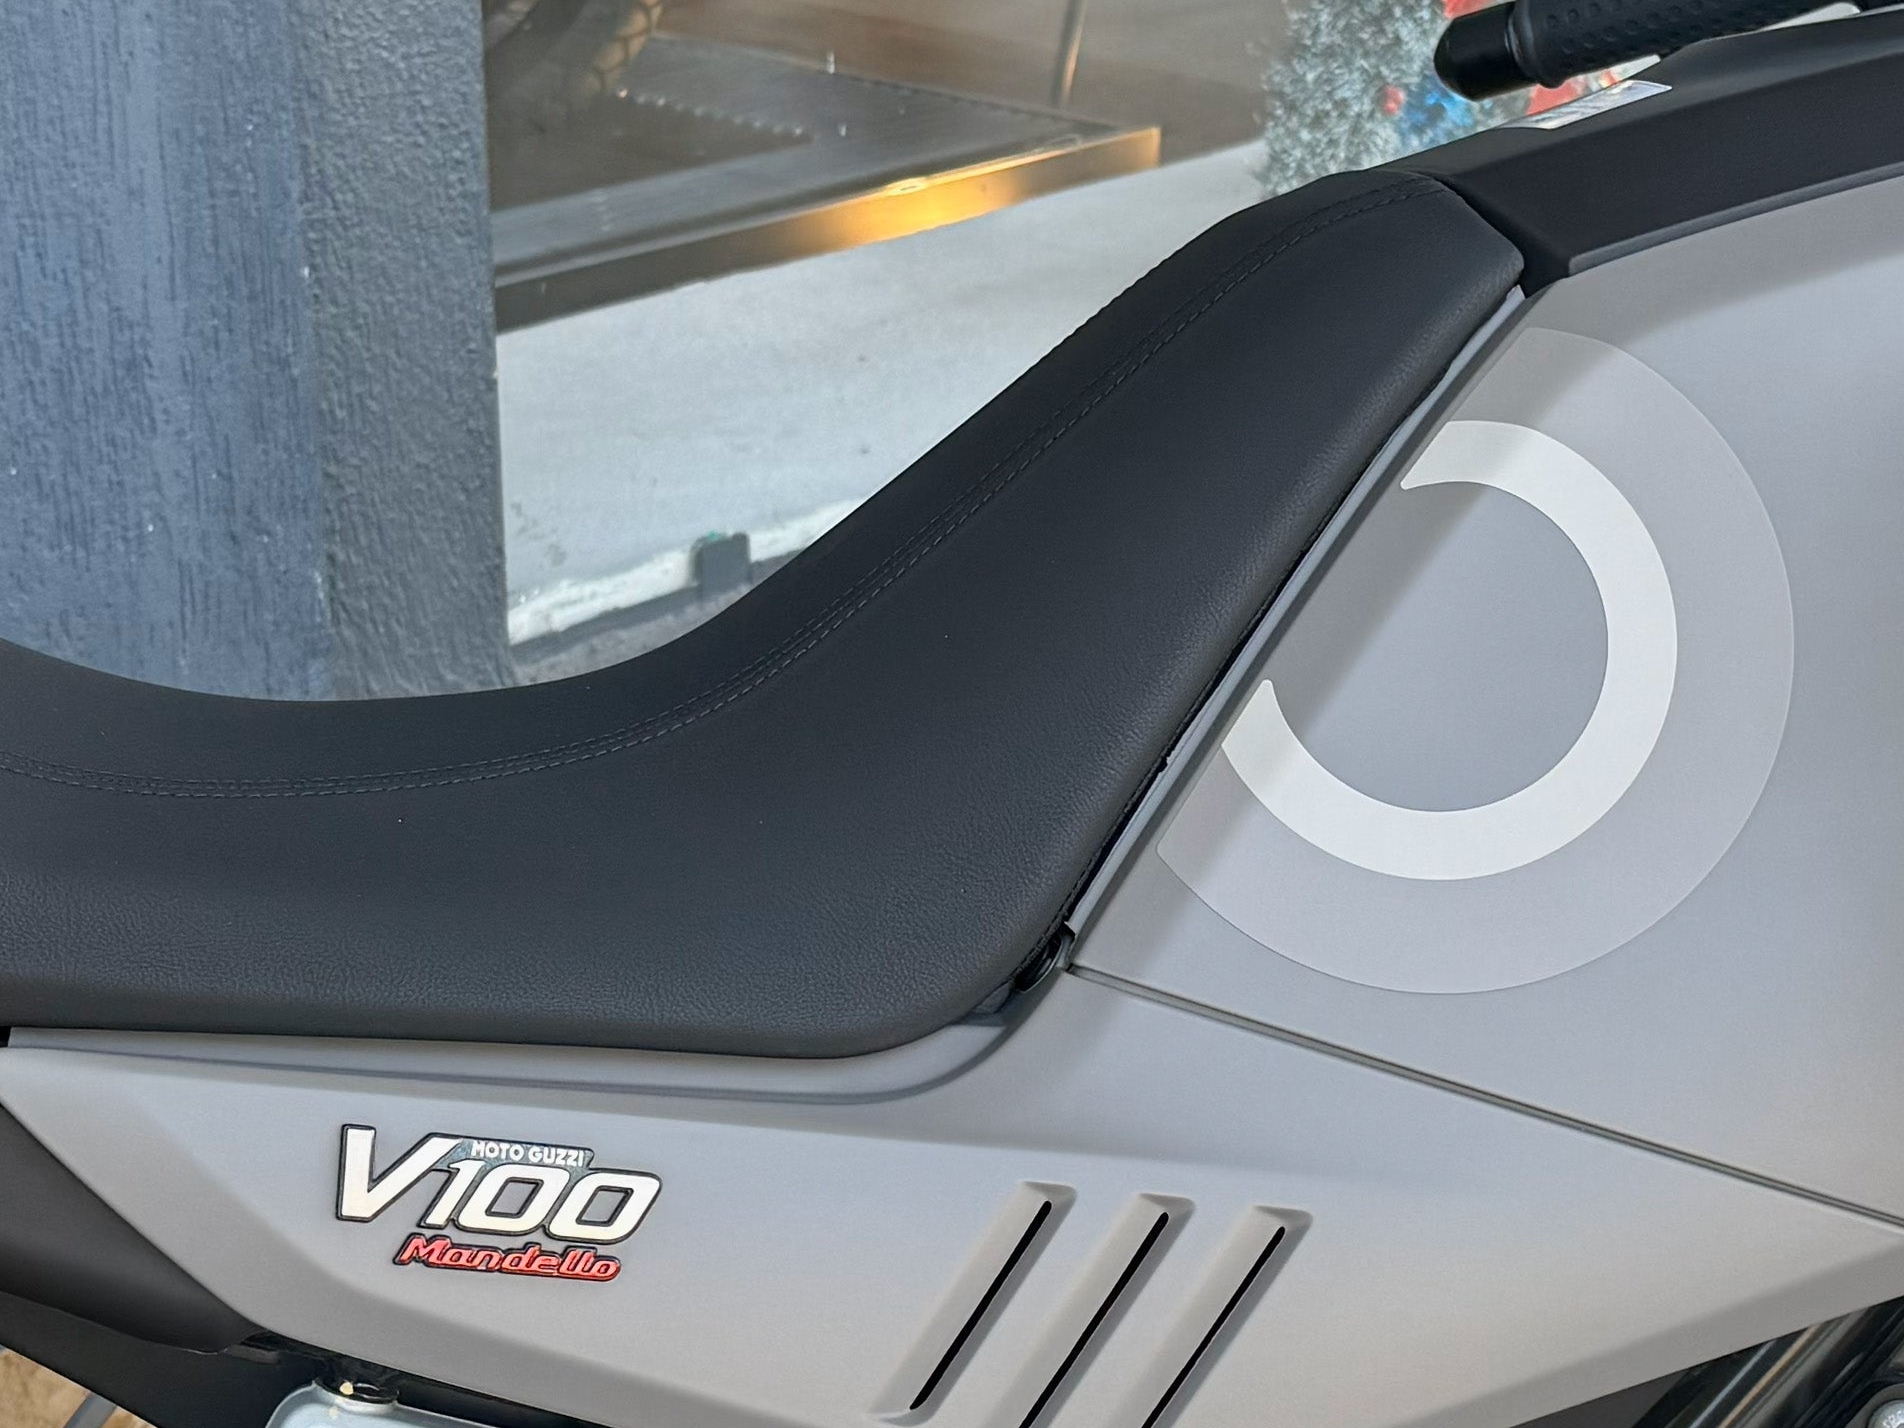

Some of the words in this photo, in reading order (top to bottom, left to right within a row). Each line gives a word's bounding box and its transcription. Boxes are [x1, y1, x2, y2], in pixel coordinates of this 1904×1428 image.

[470, 1139, 525, 1163] MOTO
[529, 1145, 586, 1168] GUZZI
[335, 1123, 663, 1245] V100
[393, 1232, 623, 1283] Mandello
